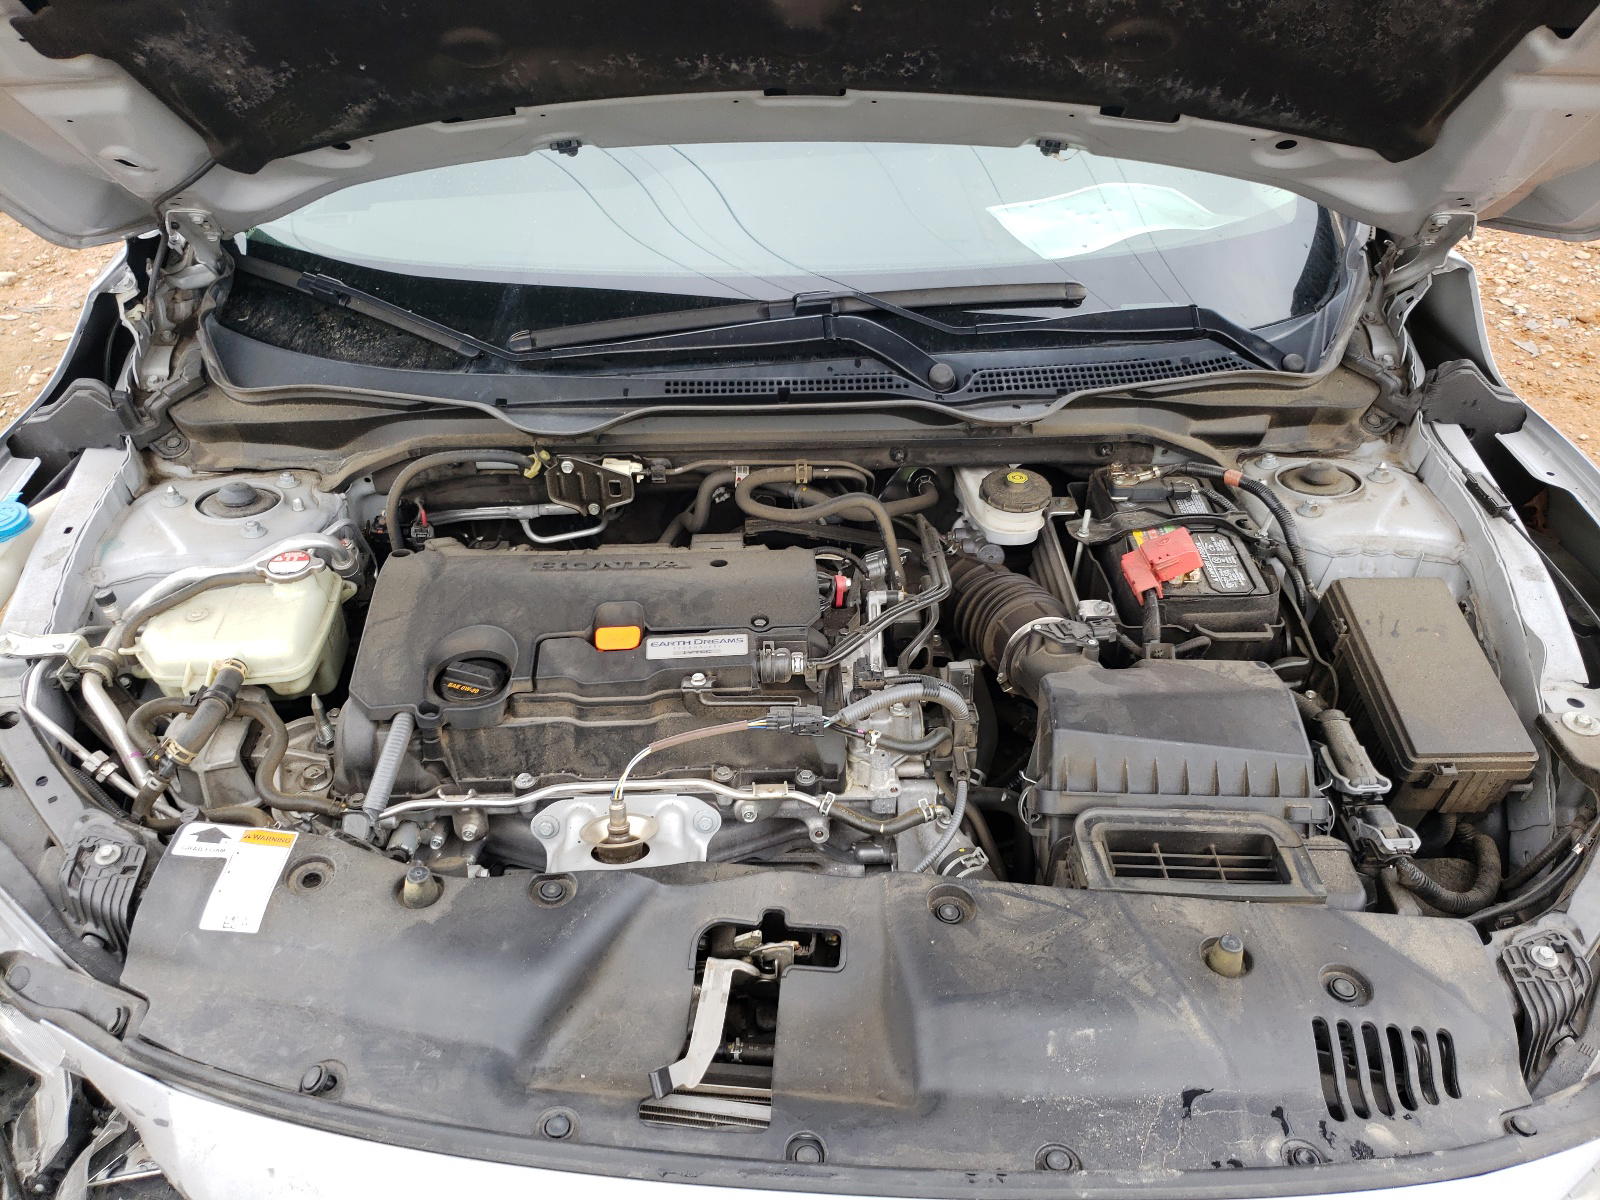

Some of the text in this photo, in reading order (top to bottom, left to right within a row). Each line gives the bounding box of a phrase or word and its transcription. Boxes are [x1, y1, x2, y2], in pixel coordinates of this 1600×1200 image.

[531, 561, 691, 571] HONDA
[650, 640, 691, 648] EARTH
[693, 637, 744, 647] DREAMS
[253, 834, 291, 844] WARNING
